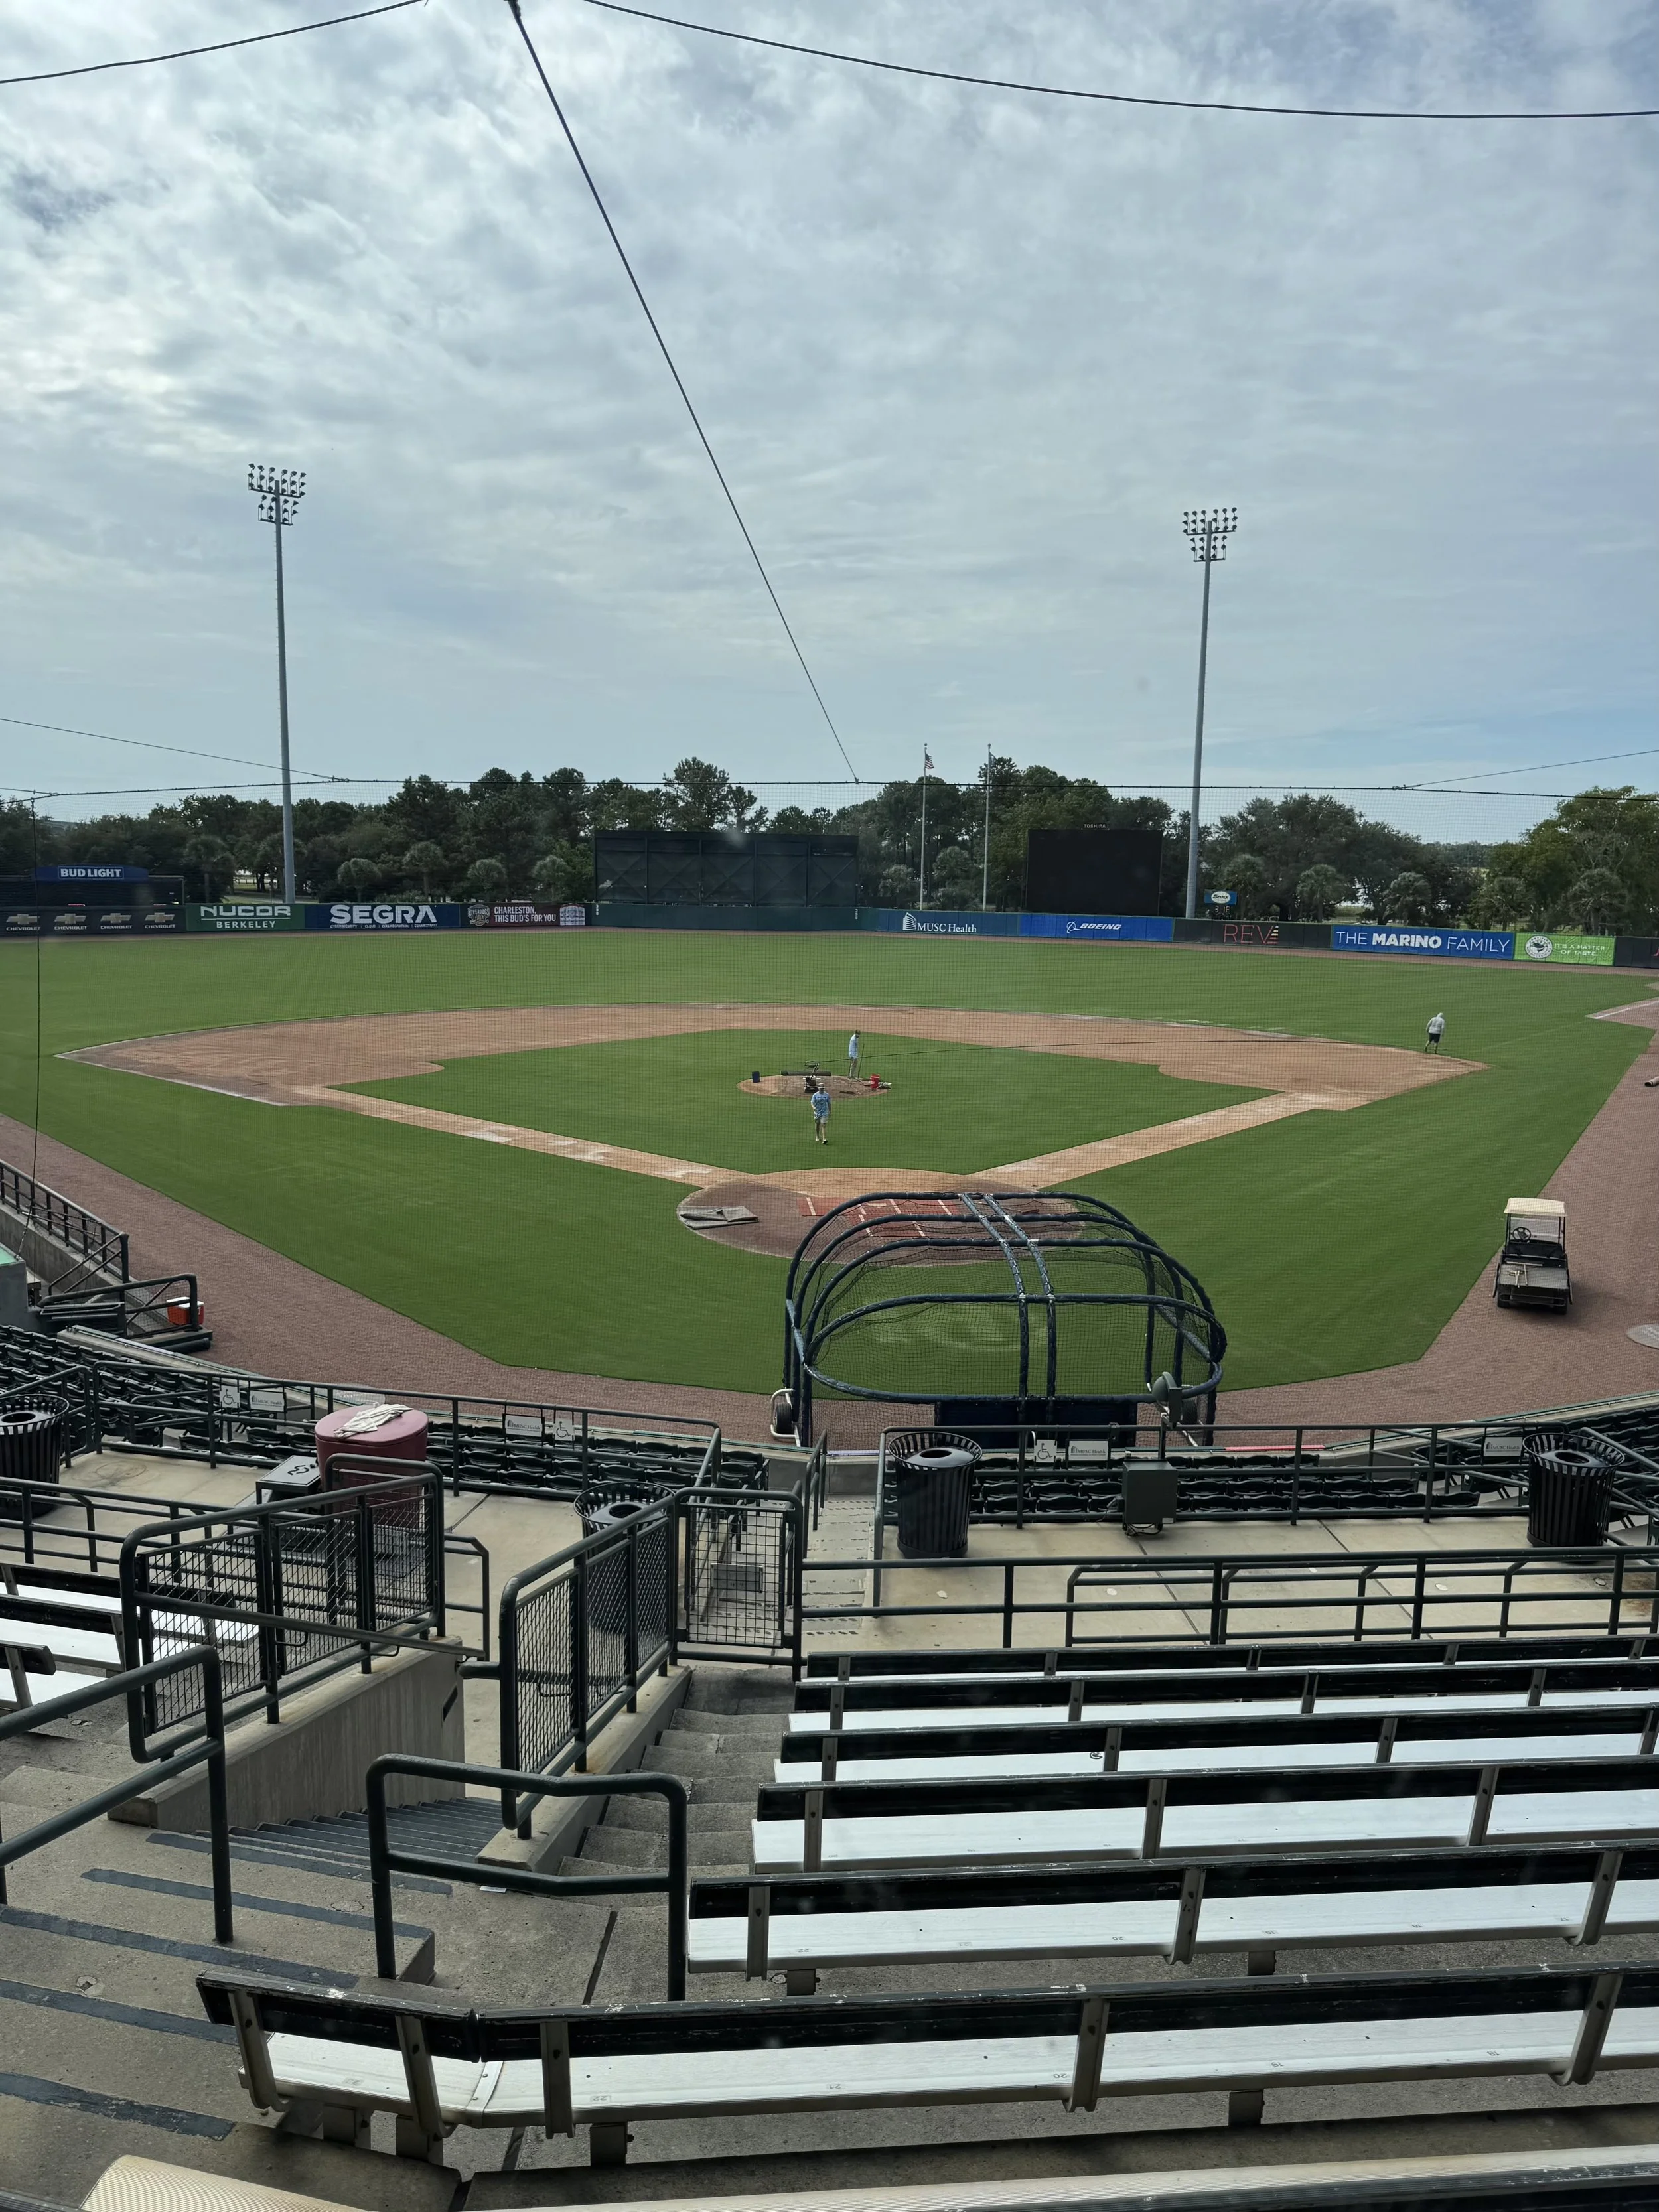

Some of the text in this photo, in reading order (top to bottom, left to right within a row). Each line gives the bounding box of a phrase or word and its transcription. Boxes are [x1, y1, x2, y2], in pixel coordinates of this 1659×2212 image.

[60, 868, 121, 878] BUD LIGHT
[200, 905, 291, 917] NUCOR
[330, 904, 437, 924] SEGRA
[917, 922, 977, 933] MUSC Health
[1336, 931, 1368, 945] THE
[1372, 933, 1442, 949] MARINO
[1447, 937, 1510, 953] FAMILY
